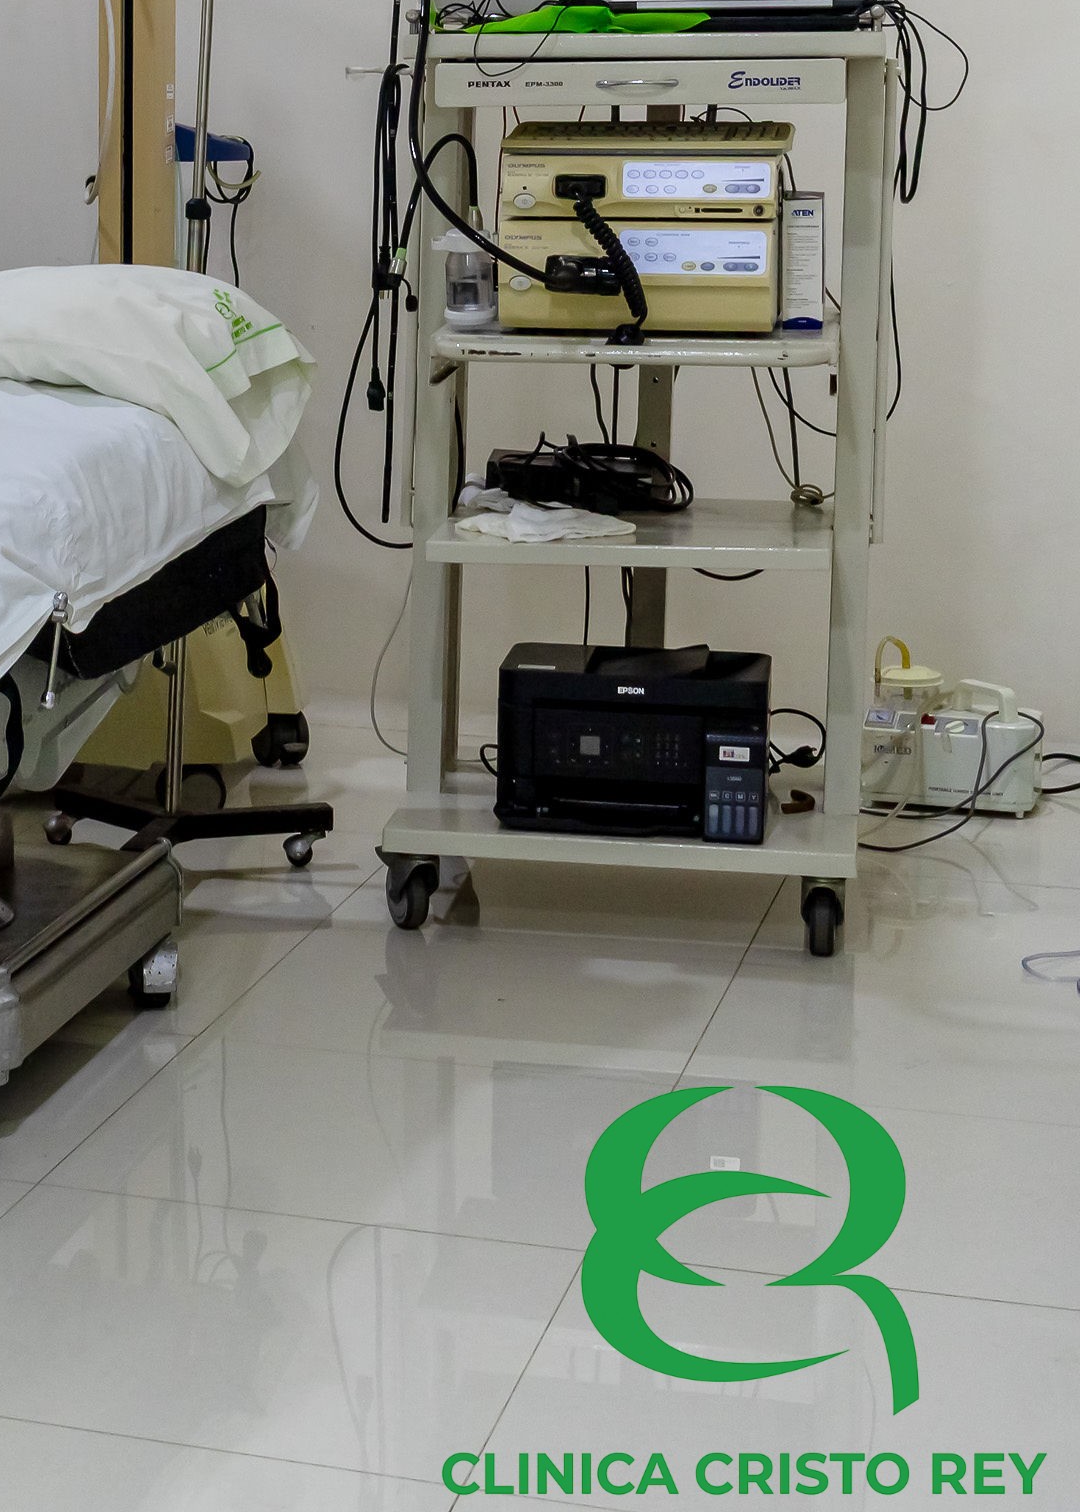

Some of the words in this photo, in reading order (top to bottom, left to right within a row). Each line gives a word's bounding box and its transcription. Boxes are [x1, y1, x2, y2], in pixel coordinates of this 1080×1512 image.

[467, 80, 512, 88] PENTAX
[791, 209, 814, 217] ATEN
[617, 686, 645, 695] EPSON
